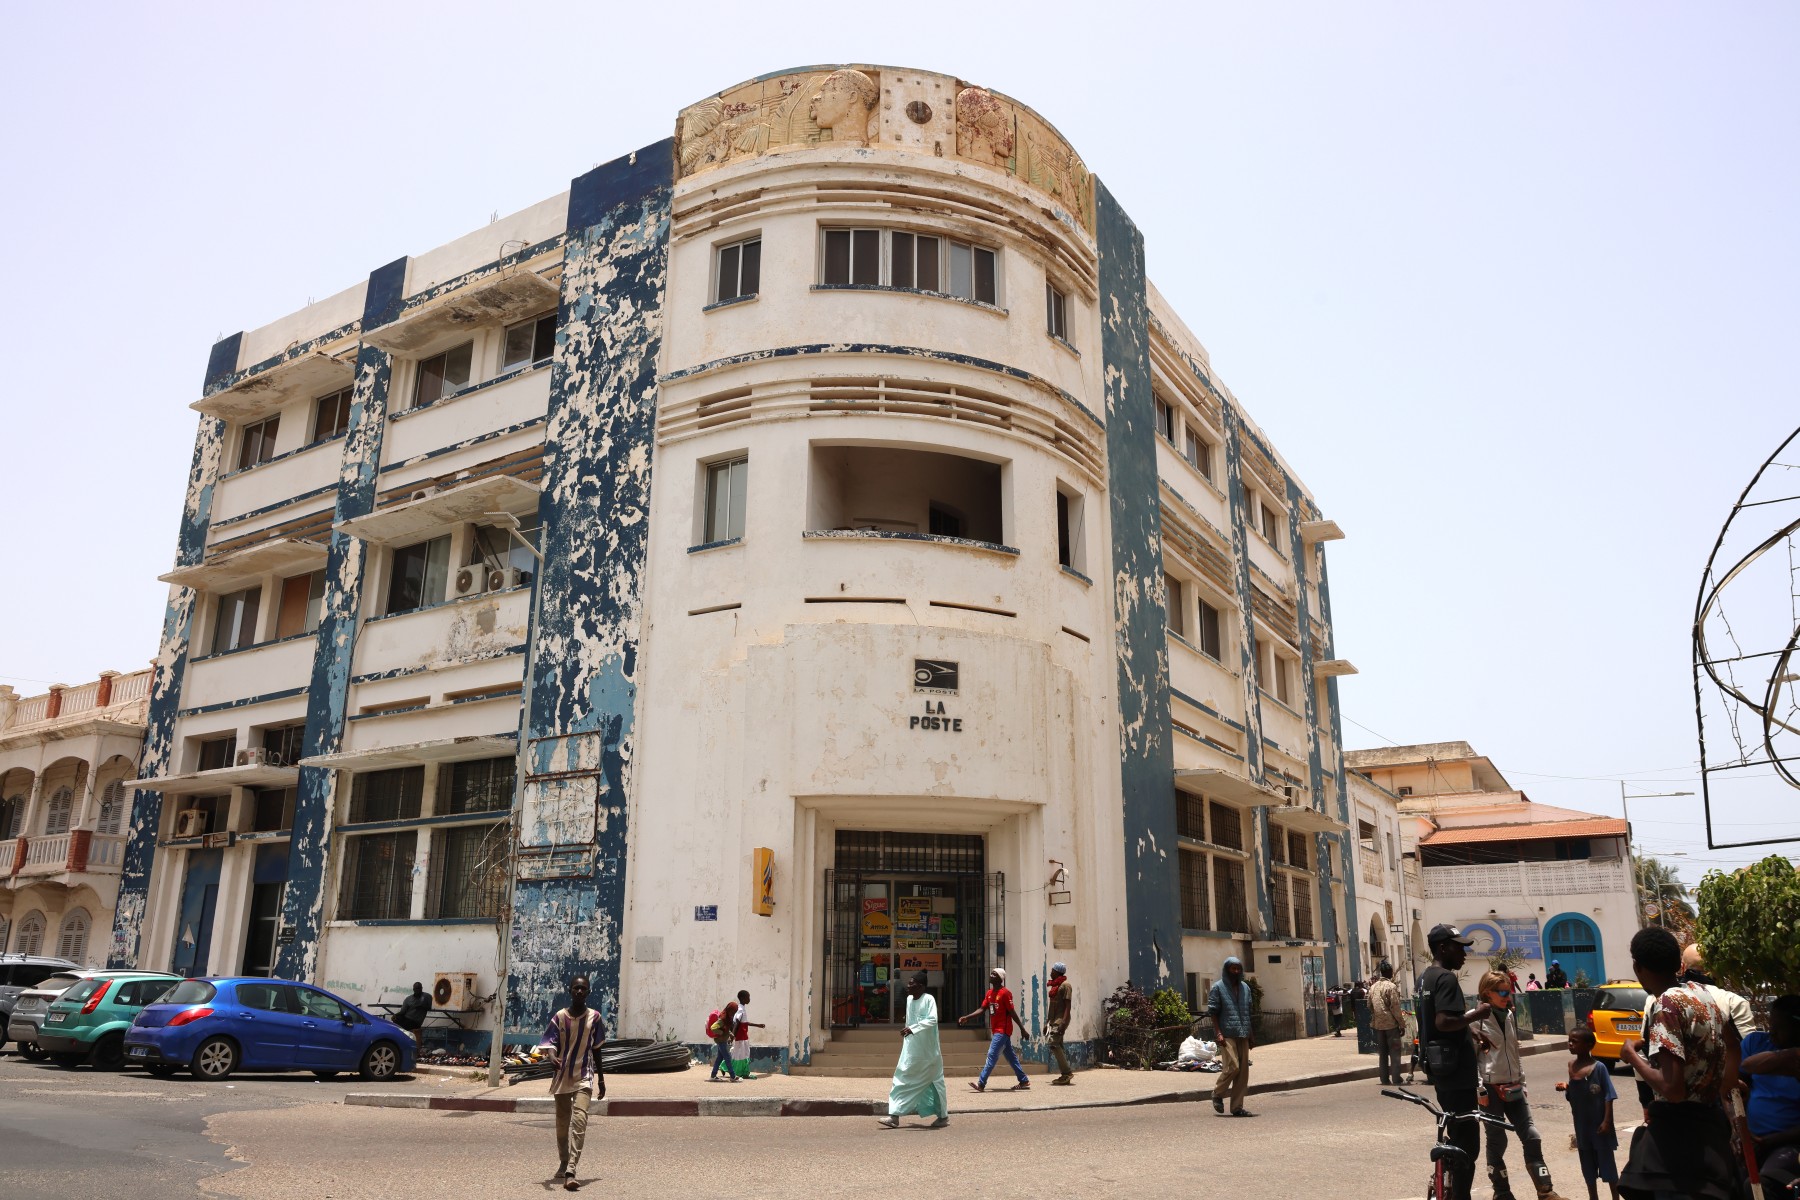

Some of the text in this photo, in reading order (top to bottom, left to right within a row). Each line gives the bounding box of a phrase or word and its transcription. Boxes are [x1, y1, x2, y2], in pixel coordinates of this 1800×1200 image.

[926, 700, 945, 714] LA
[909, 716, 962, 732] POSTE
[864, 900, 886, 910] Sigue
[904, 957, 922, 967] Ria
